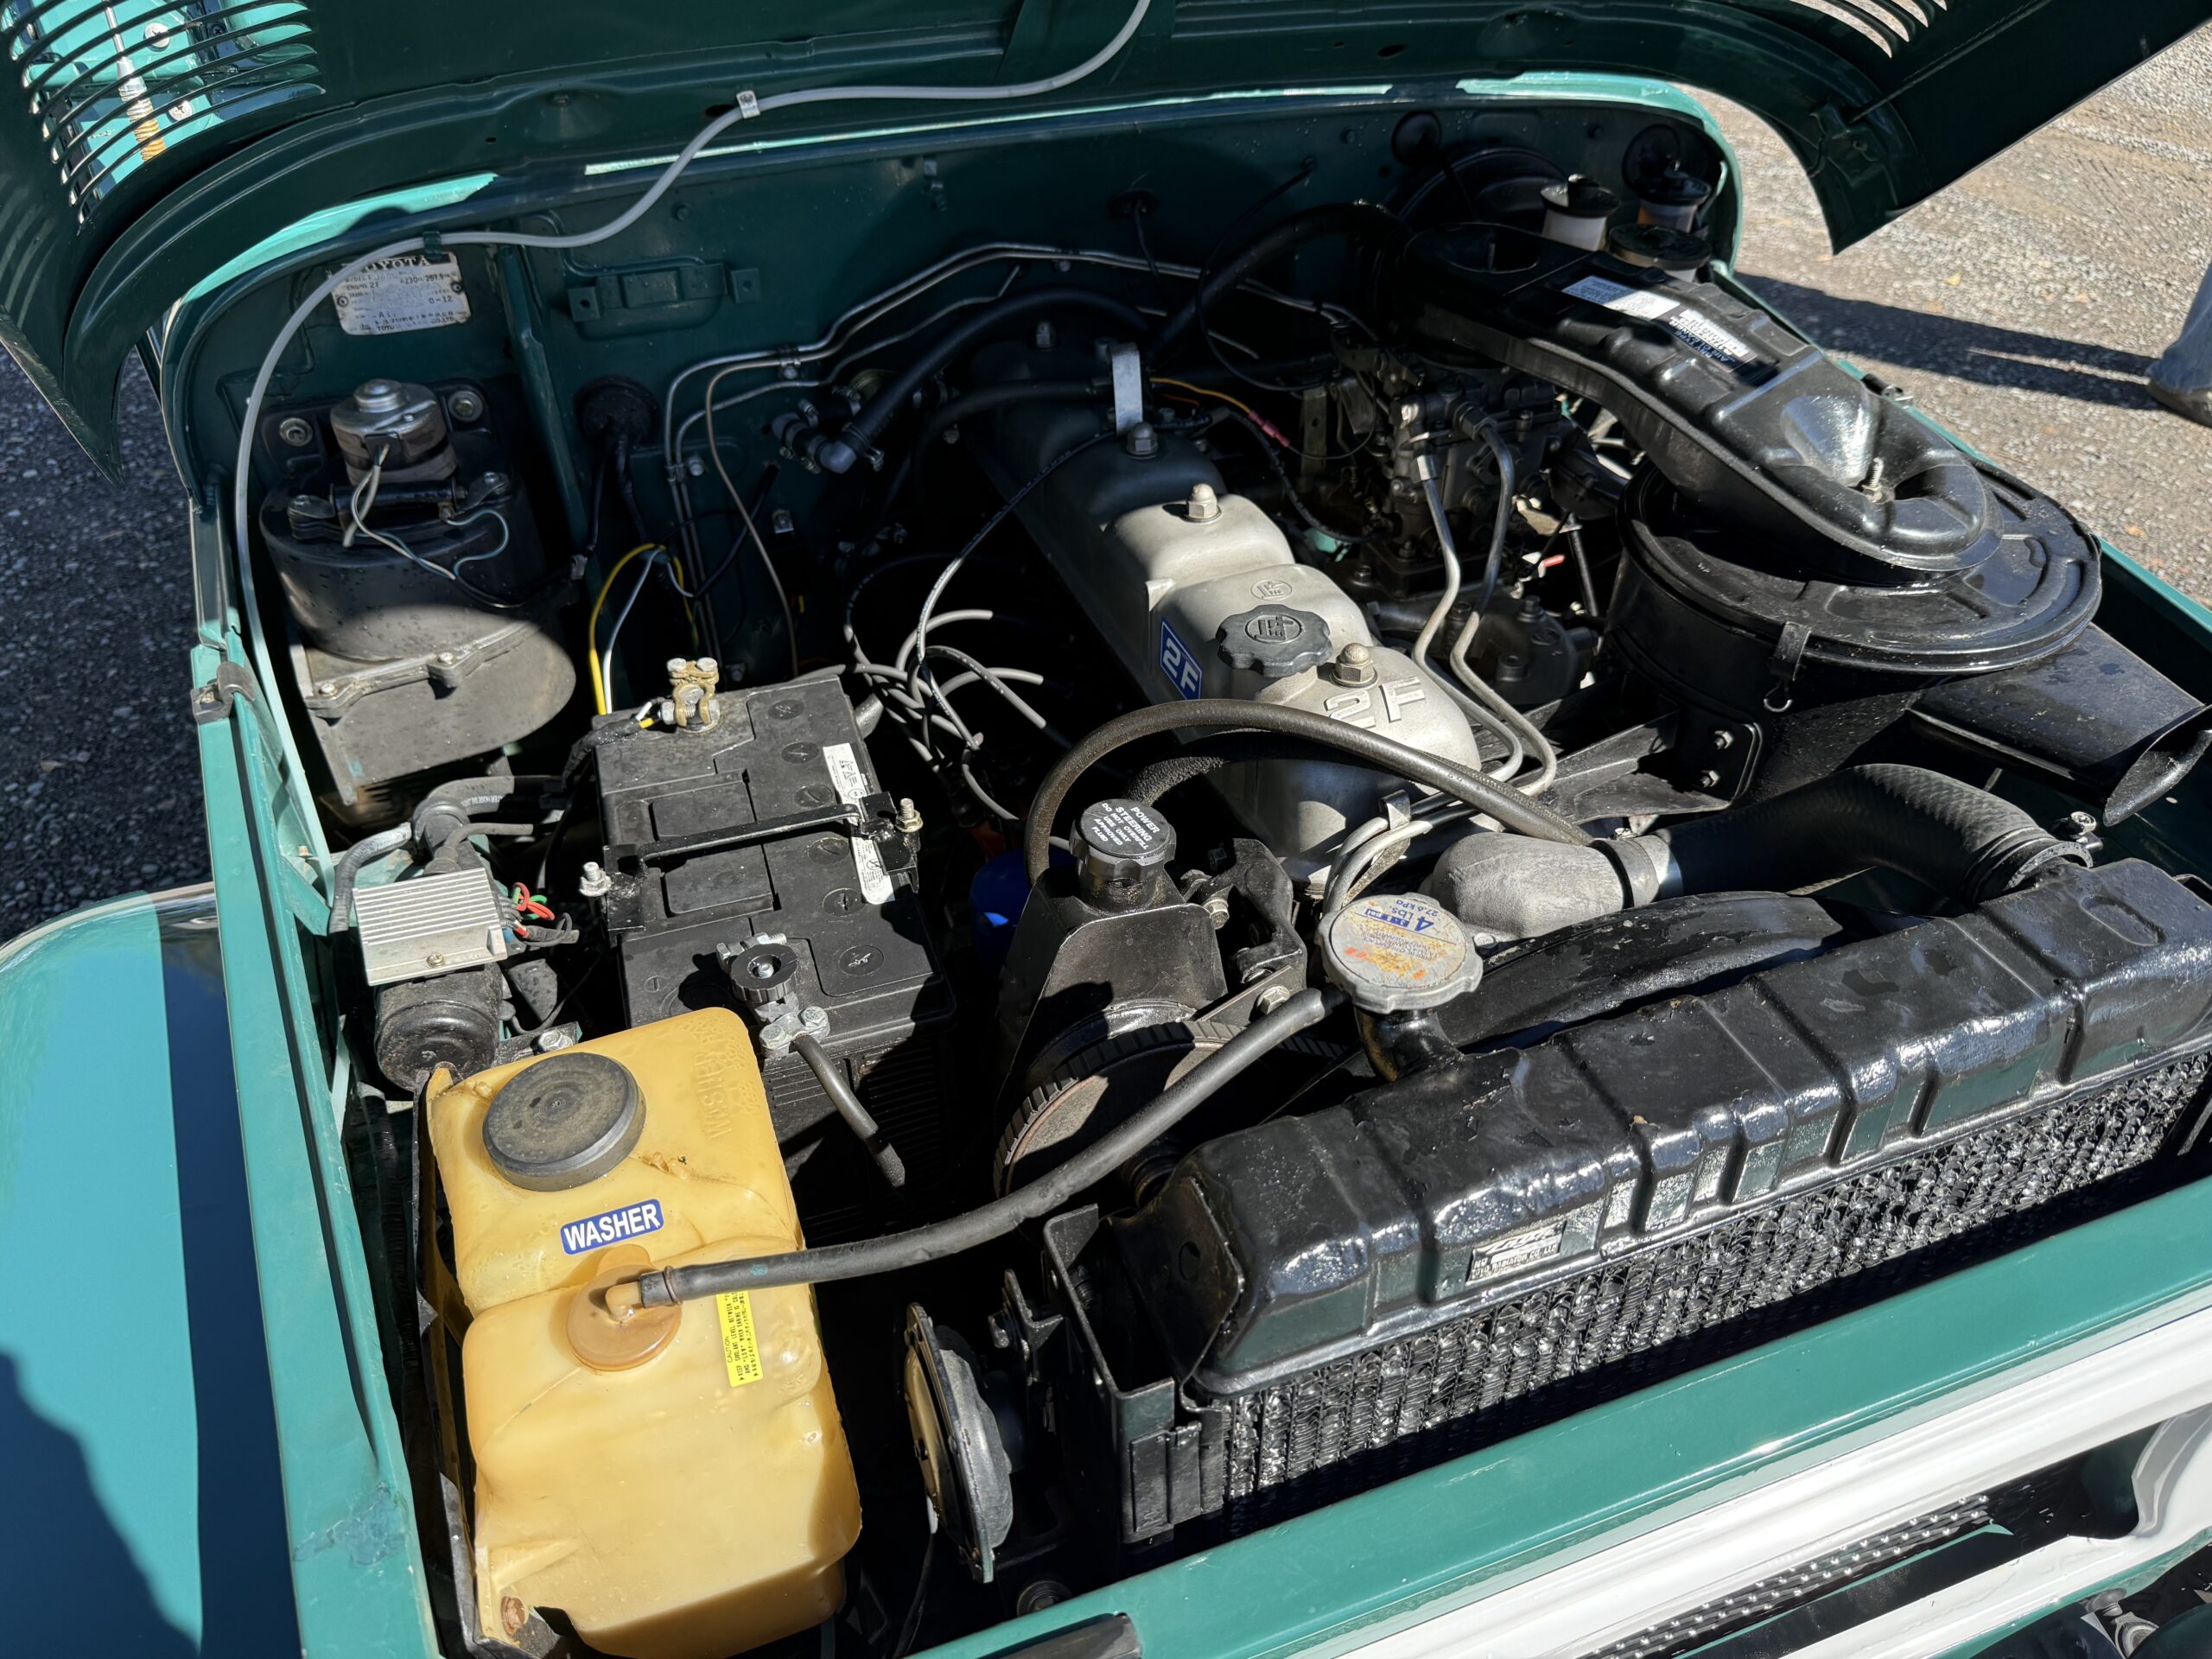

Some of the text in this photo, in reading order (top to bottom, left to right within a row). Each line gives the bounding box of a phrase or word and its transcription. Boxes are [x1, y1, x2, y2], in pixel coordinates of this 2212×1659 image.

[1162, 637, 1199, 693] 2F
[1323, 676, 1427, 729] 2F
[1093, 818, 1123, 846] APPROVED
[1101, 803, 1149, 850] DO NOT OVERFILL
[1103, 816, 1132, 842] USE ONLY
[1115, 806, 1153, 842] STEERING
[1130, 806, 1160, 834] POWER
[1091, 826, 1109, 842] FLUID
[1389, 906, 1414, 920] Lbs.
[1395, 899, 1440, 917] 27.6 kPa
[1414, 916, 1434, 931] 4
[563, 1204, 661, 1251] WASHER
[724, 1336, 734, 1363] CAUTION
[732, 1342, 741, 1362] COOLANT
[735, 1365, 744, 1376] KEEP
